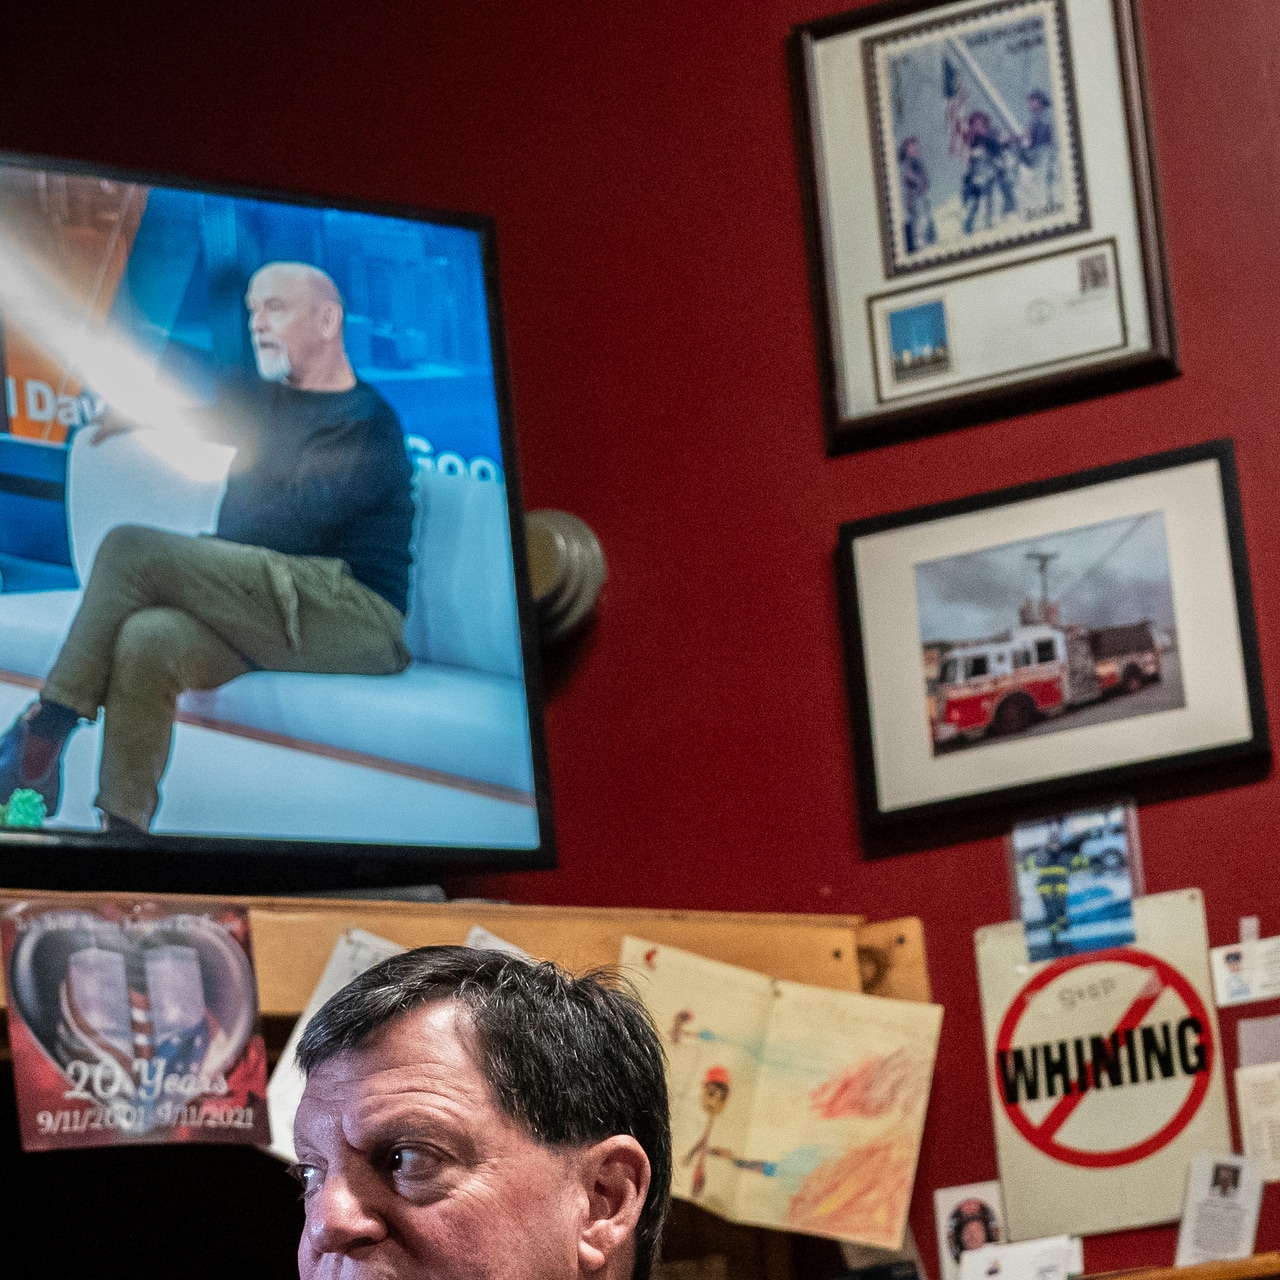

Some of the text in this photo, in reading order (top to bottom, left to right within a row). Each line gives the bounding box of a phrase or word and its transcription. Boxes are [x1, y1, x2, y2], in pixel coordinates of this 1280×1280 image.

[64, 1057, 230, 1100] 20 Years
[998, 1016, 1207, 1104] WHINING
[37, 1105, 146, 1134] 9/11/2001
